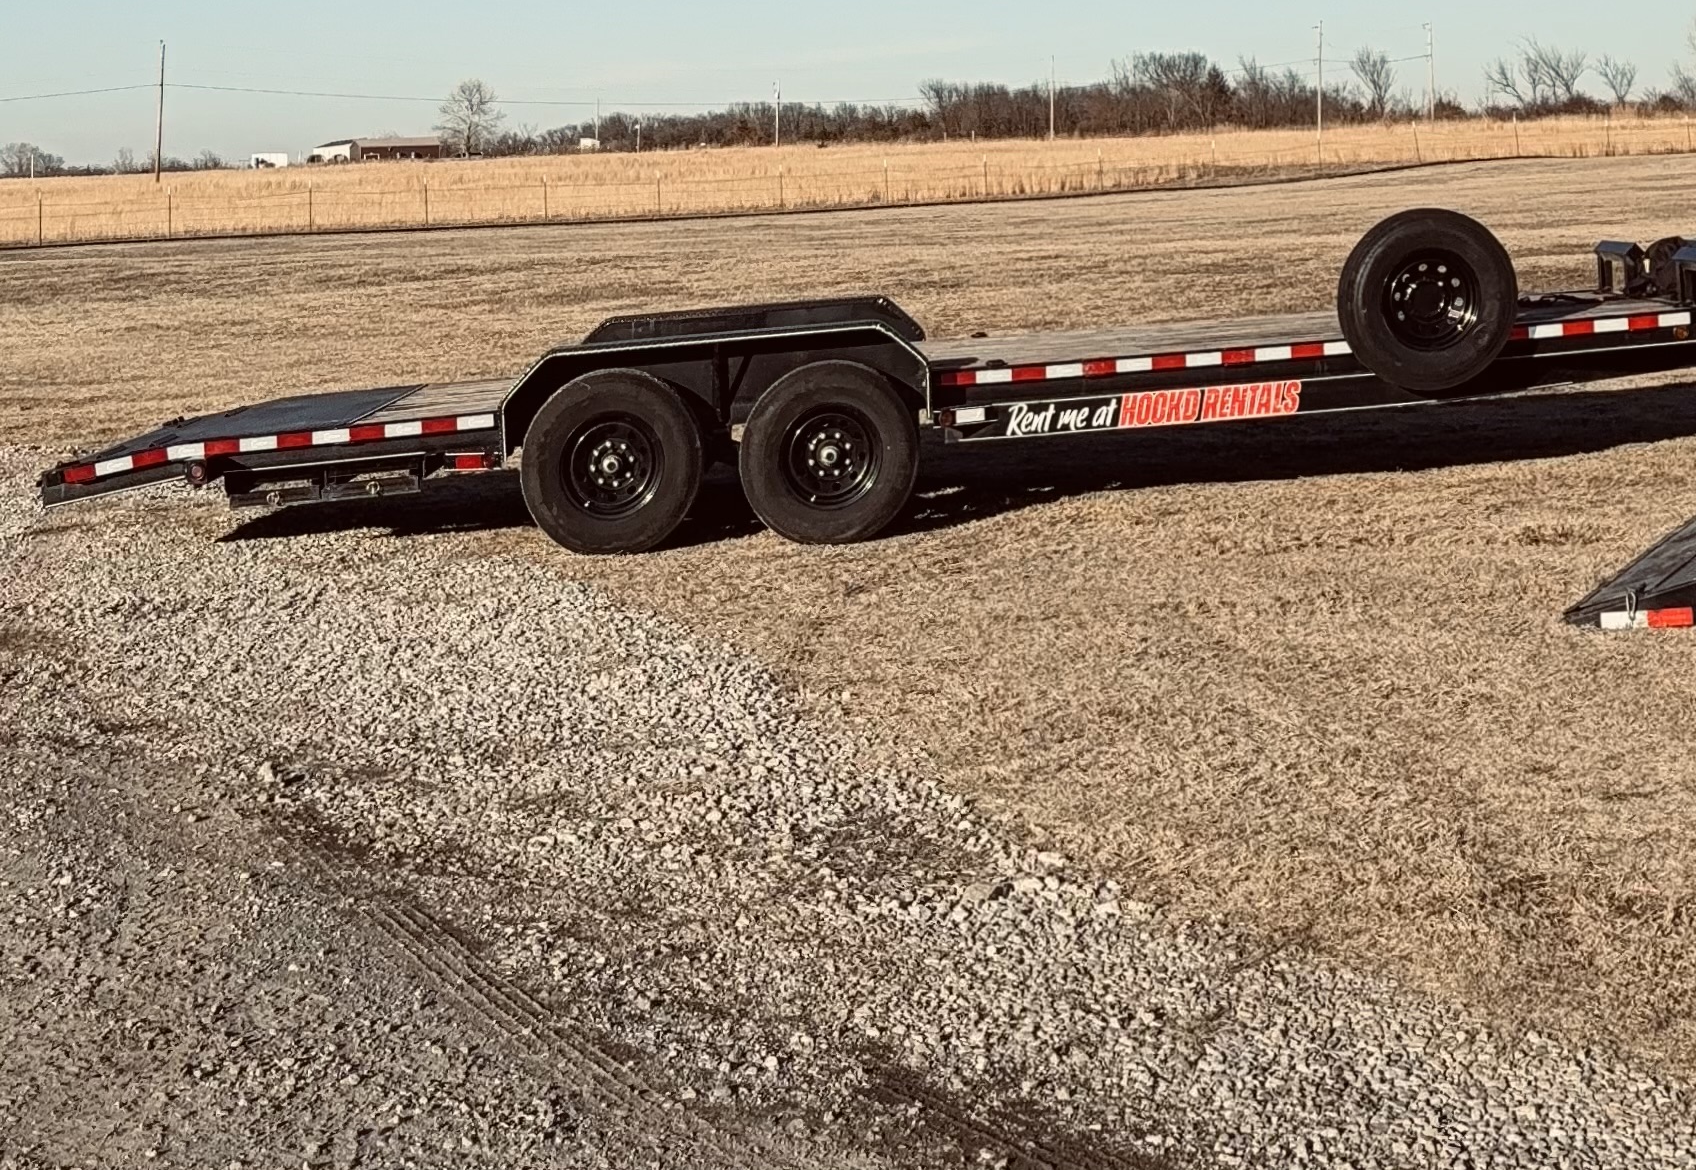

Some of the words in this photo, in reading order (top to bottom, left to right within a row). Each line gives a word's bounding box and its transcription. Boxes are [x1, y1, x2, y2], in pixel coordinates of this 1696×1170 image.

[1005, 403, 1055, 436] Rent
[1057, 406, 1089, 431] me
[1092, 398, 1118, 427] at
[1118, 388, 1202, 428] HOOKD
[1201, 379, 1301, 421] RENTALS
